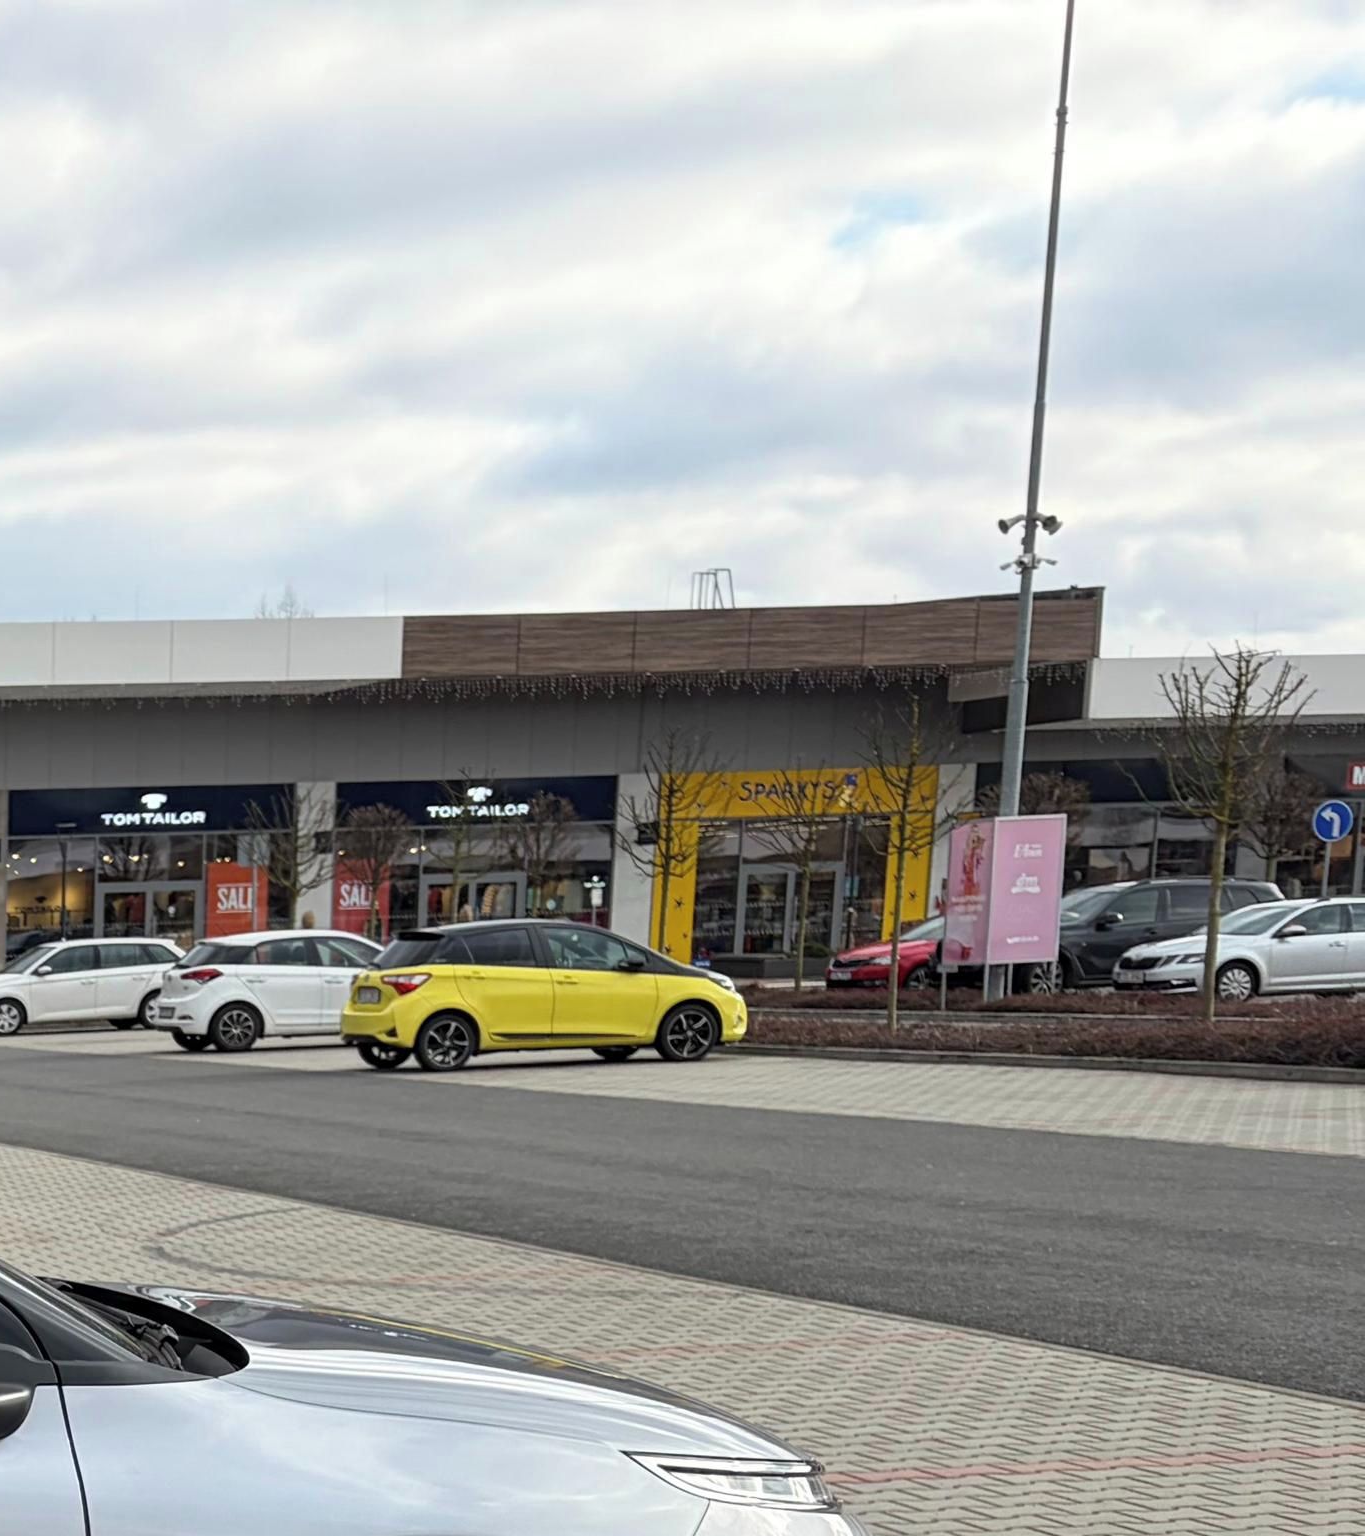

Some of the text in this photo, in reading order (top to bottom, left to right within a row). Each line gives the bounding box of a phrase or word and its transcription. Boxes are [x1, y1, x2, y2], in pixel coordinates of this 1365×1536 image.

[739, 781, 836, 802] SPARKYS
[467, 803, 530, 817] TAILOR
[100, 811, 207, 826] TOM TAILOR
